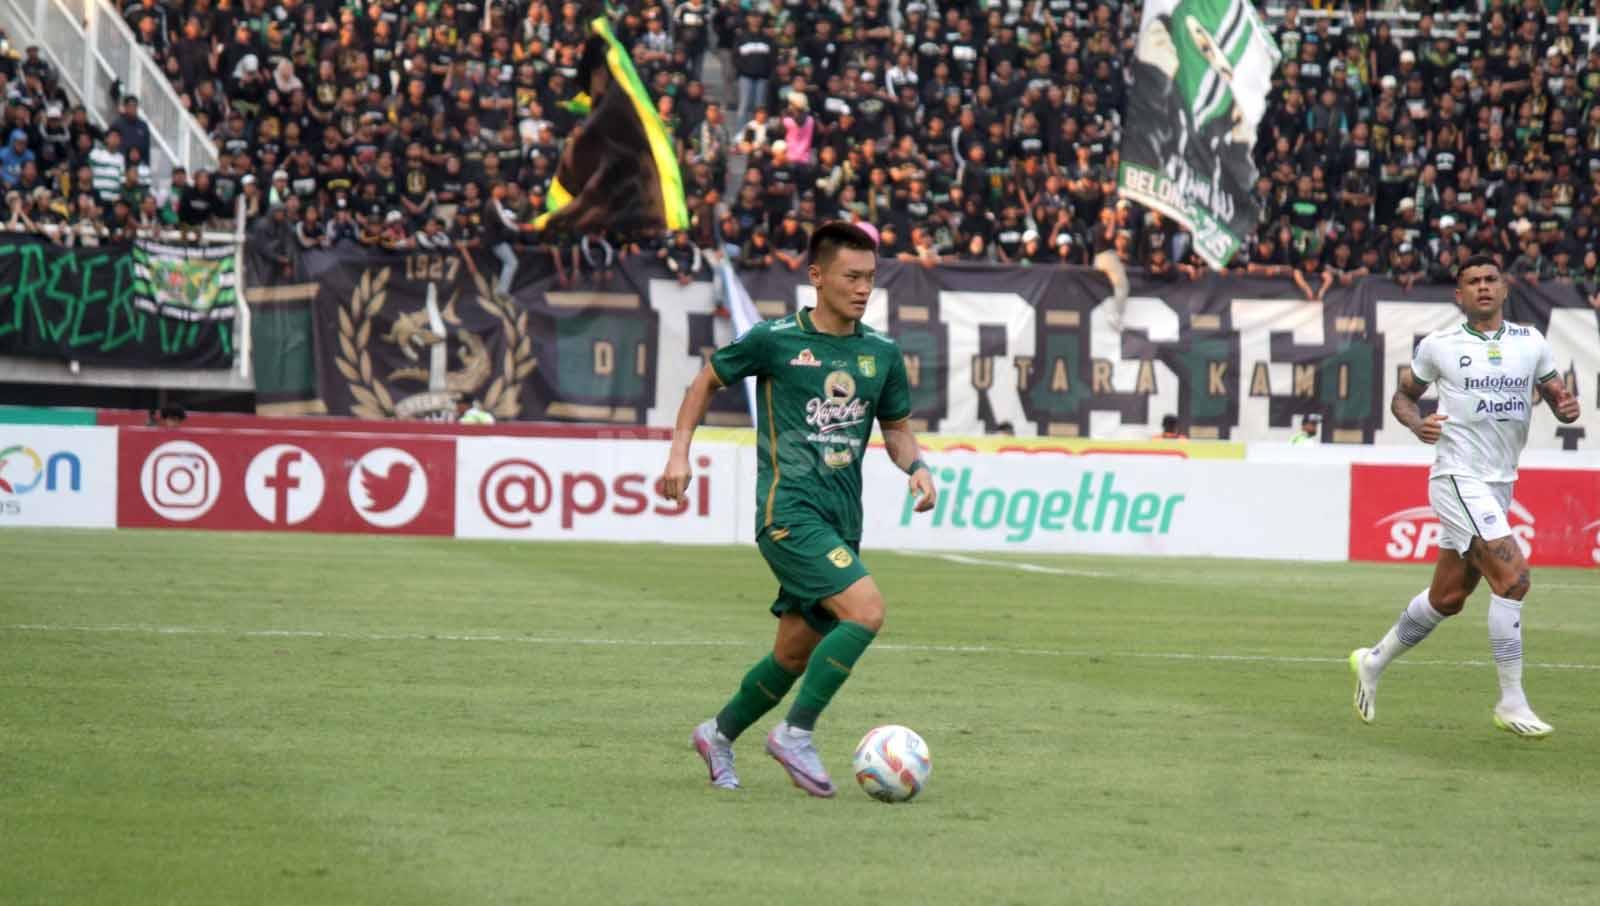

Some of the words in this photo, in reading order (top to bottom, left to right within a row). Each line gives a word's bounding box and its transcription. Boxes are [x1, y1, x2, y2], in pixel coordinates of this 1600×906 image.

[404, 254, 460, 281] 1927
[594, 341, 646, 376] DI
[972, 354, 1157, 395] UTARA
[1207, 361, 1348, 398] KAMI
[1463, 375, 1529, 392] Indofood
[1476, 397, 1525, 413] Aladin
[479, 456, 711, 530] @pssi
[1386, 520, 1536, 559] SPS
